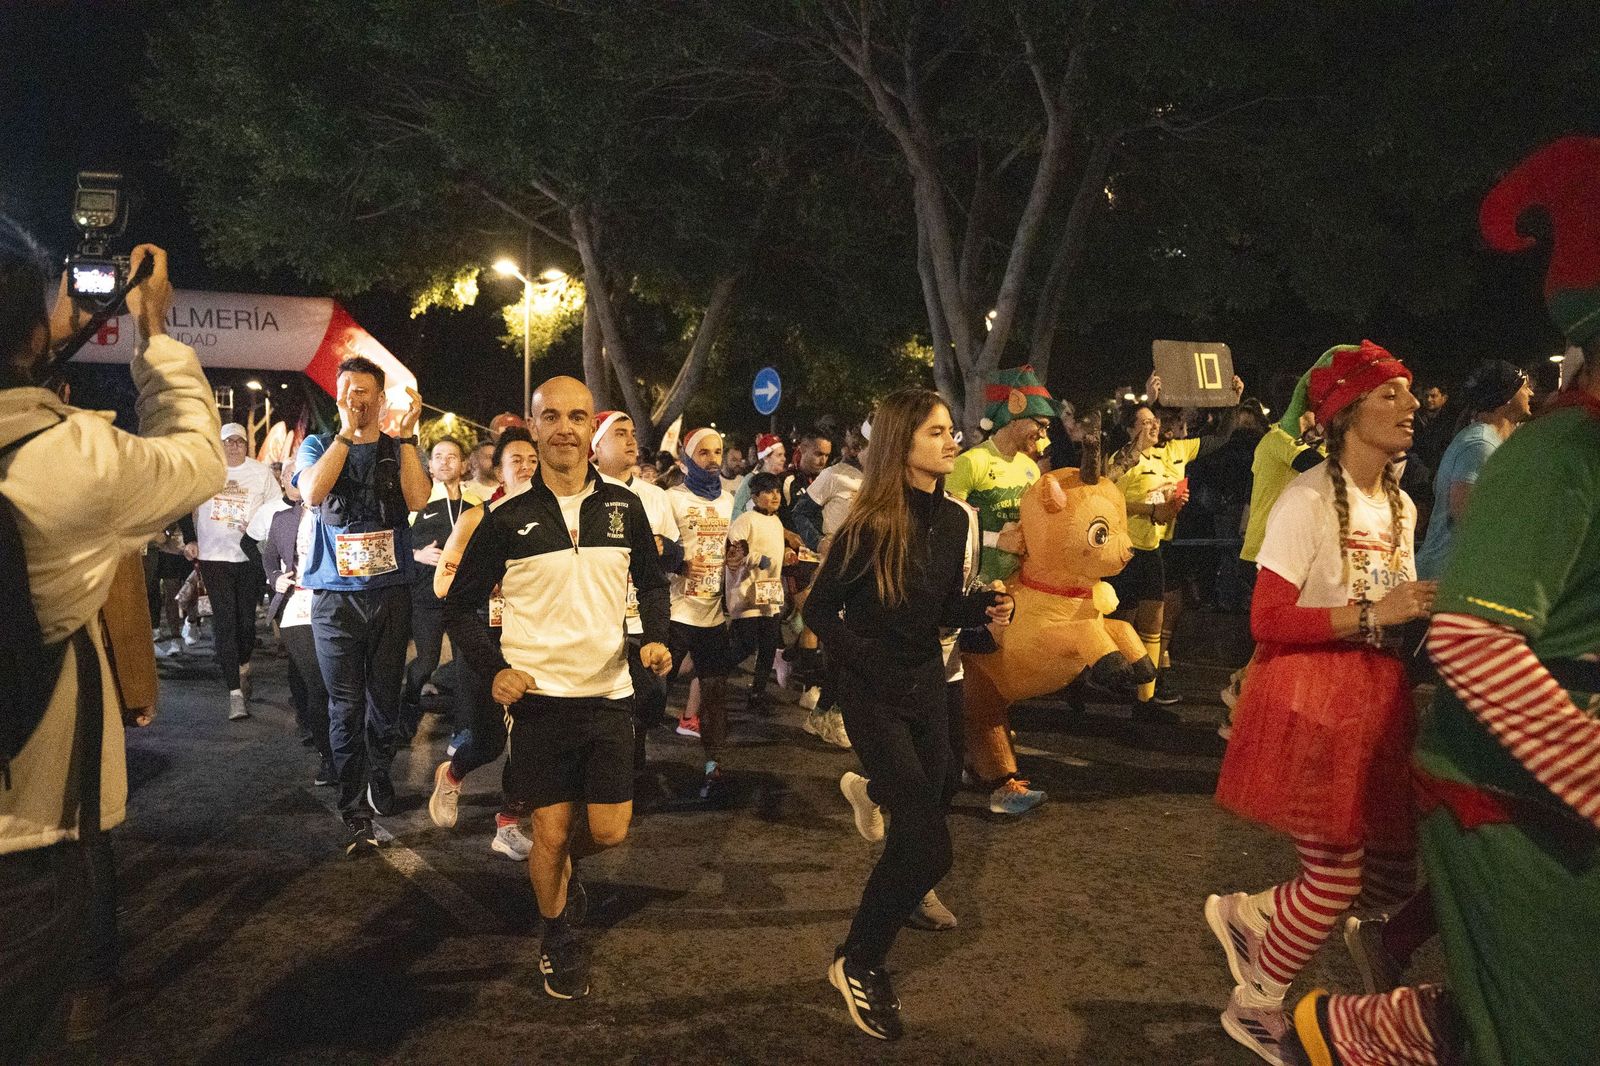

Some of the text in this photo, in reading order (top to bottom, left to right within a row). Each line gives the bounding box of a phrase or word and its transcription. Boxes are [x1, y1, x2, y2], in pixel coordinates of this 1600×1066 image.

[175, 332, 217, 346] DAD
[1193, 352, 1221, 389] 10
[351, 549, 382, 561] 1354
